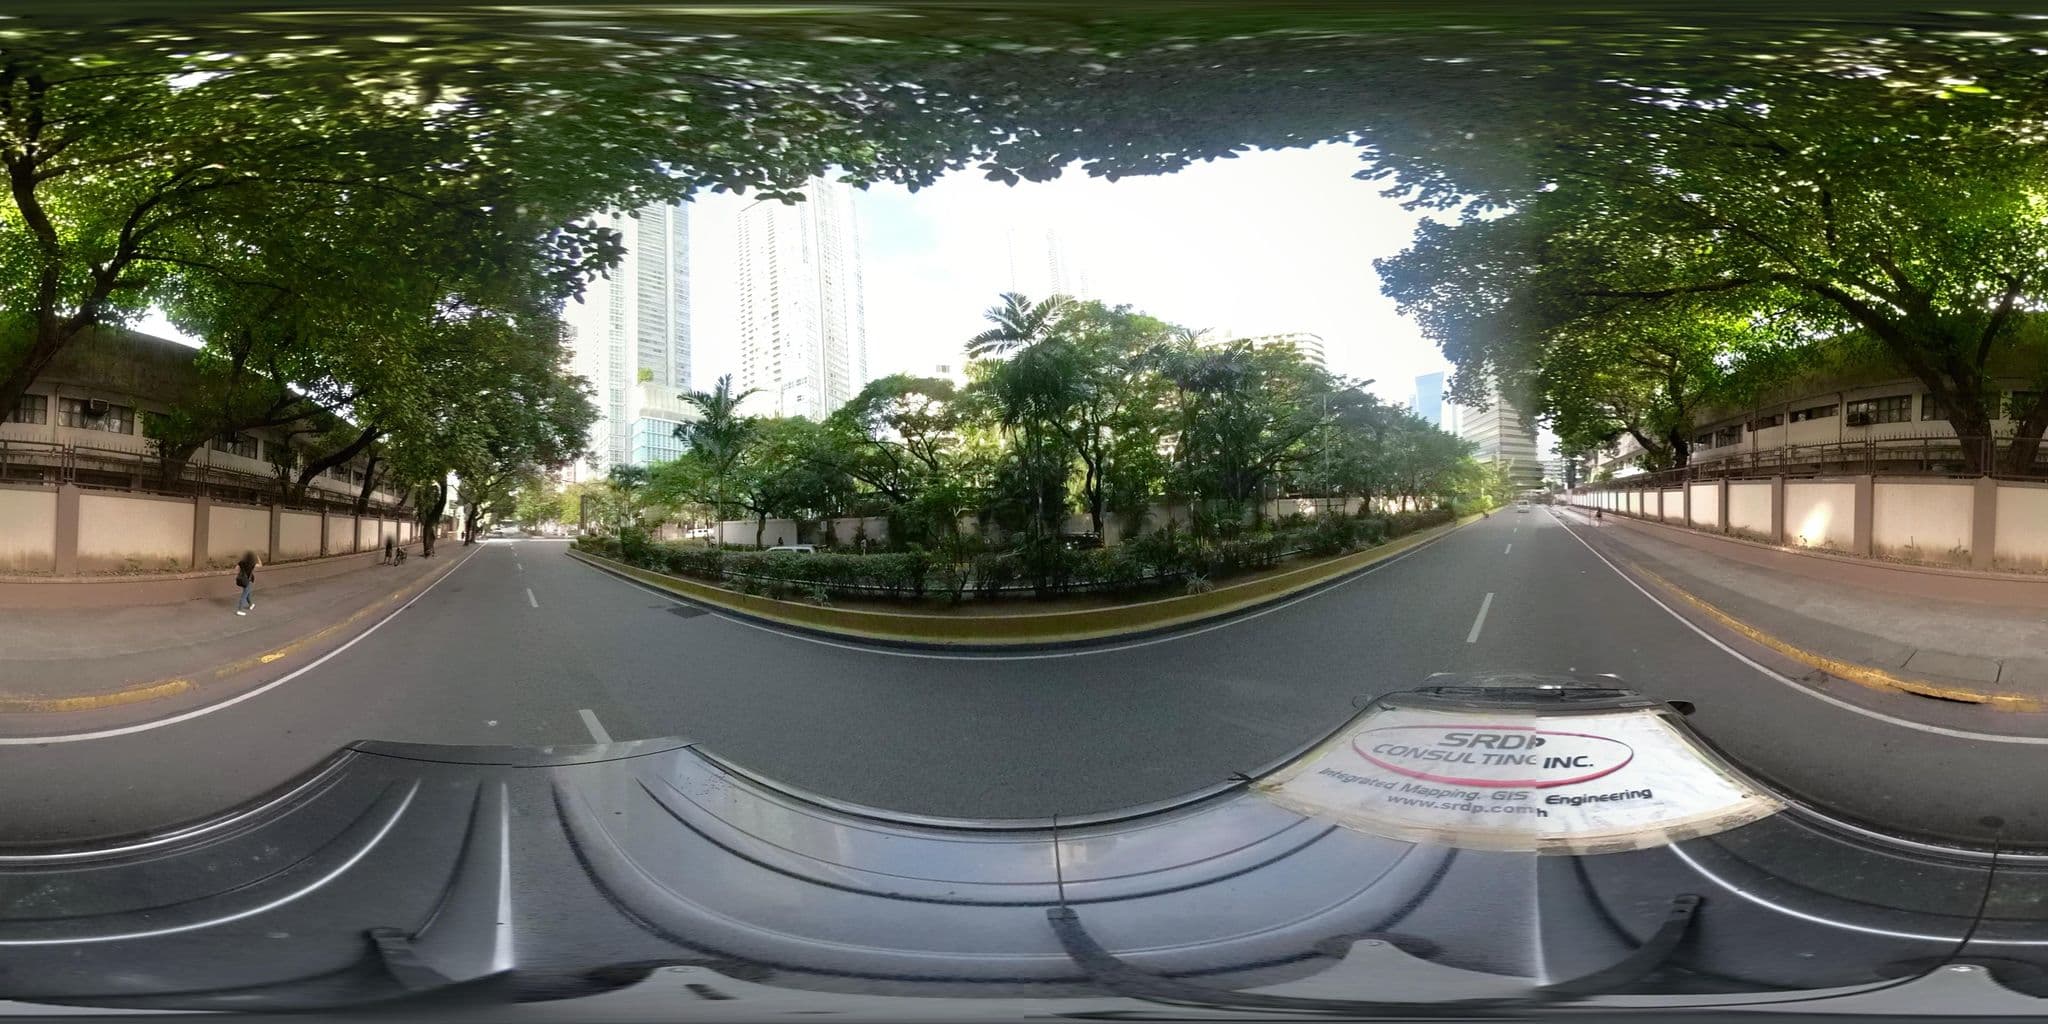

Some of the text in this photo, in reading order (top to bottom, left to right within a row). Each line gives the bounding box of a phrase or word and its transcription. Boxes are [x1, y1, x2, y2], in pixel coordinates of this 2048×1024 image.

[1438, 732, 1546, 750] SRDP
[1372, 743, 1594, 769] CONSULTING INC.
[1319, 767, 1398, 790] Integrated
[1491, 790, 1530, 801] GIS
[1545, 789, 1653, 806] Engineering
